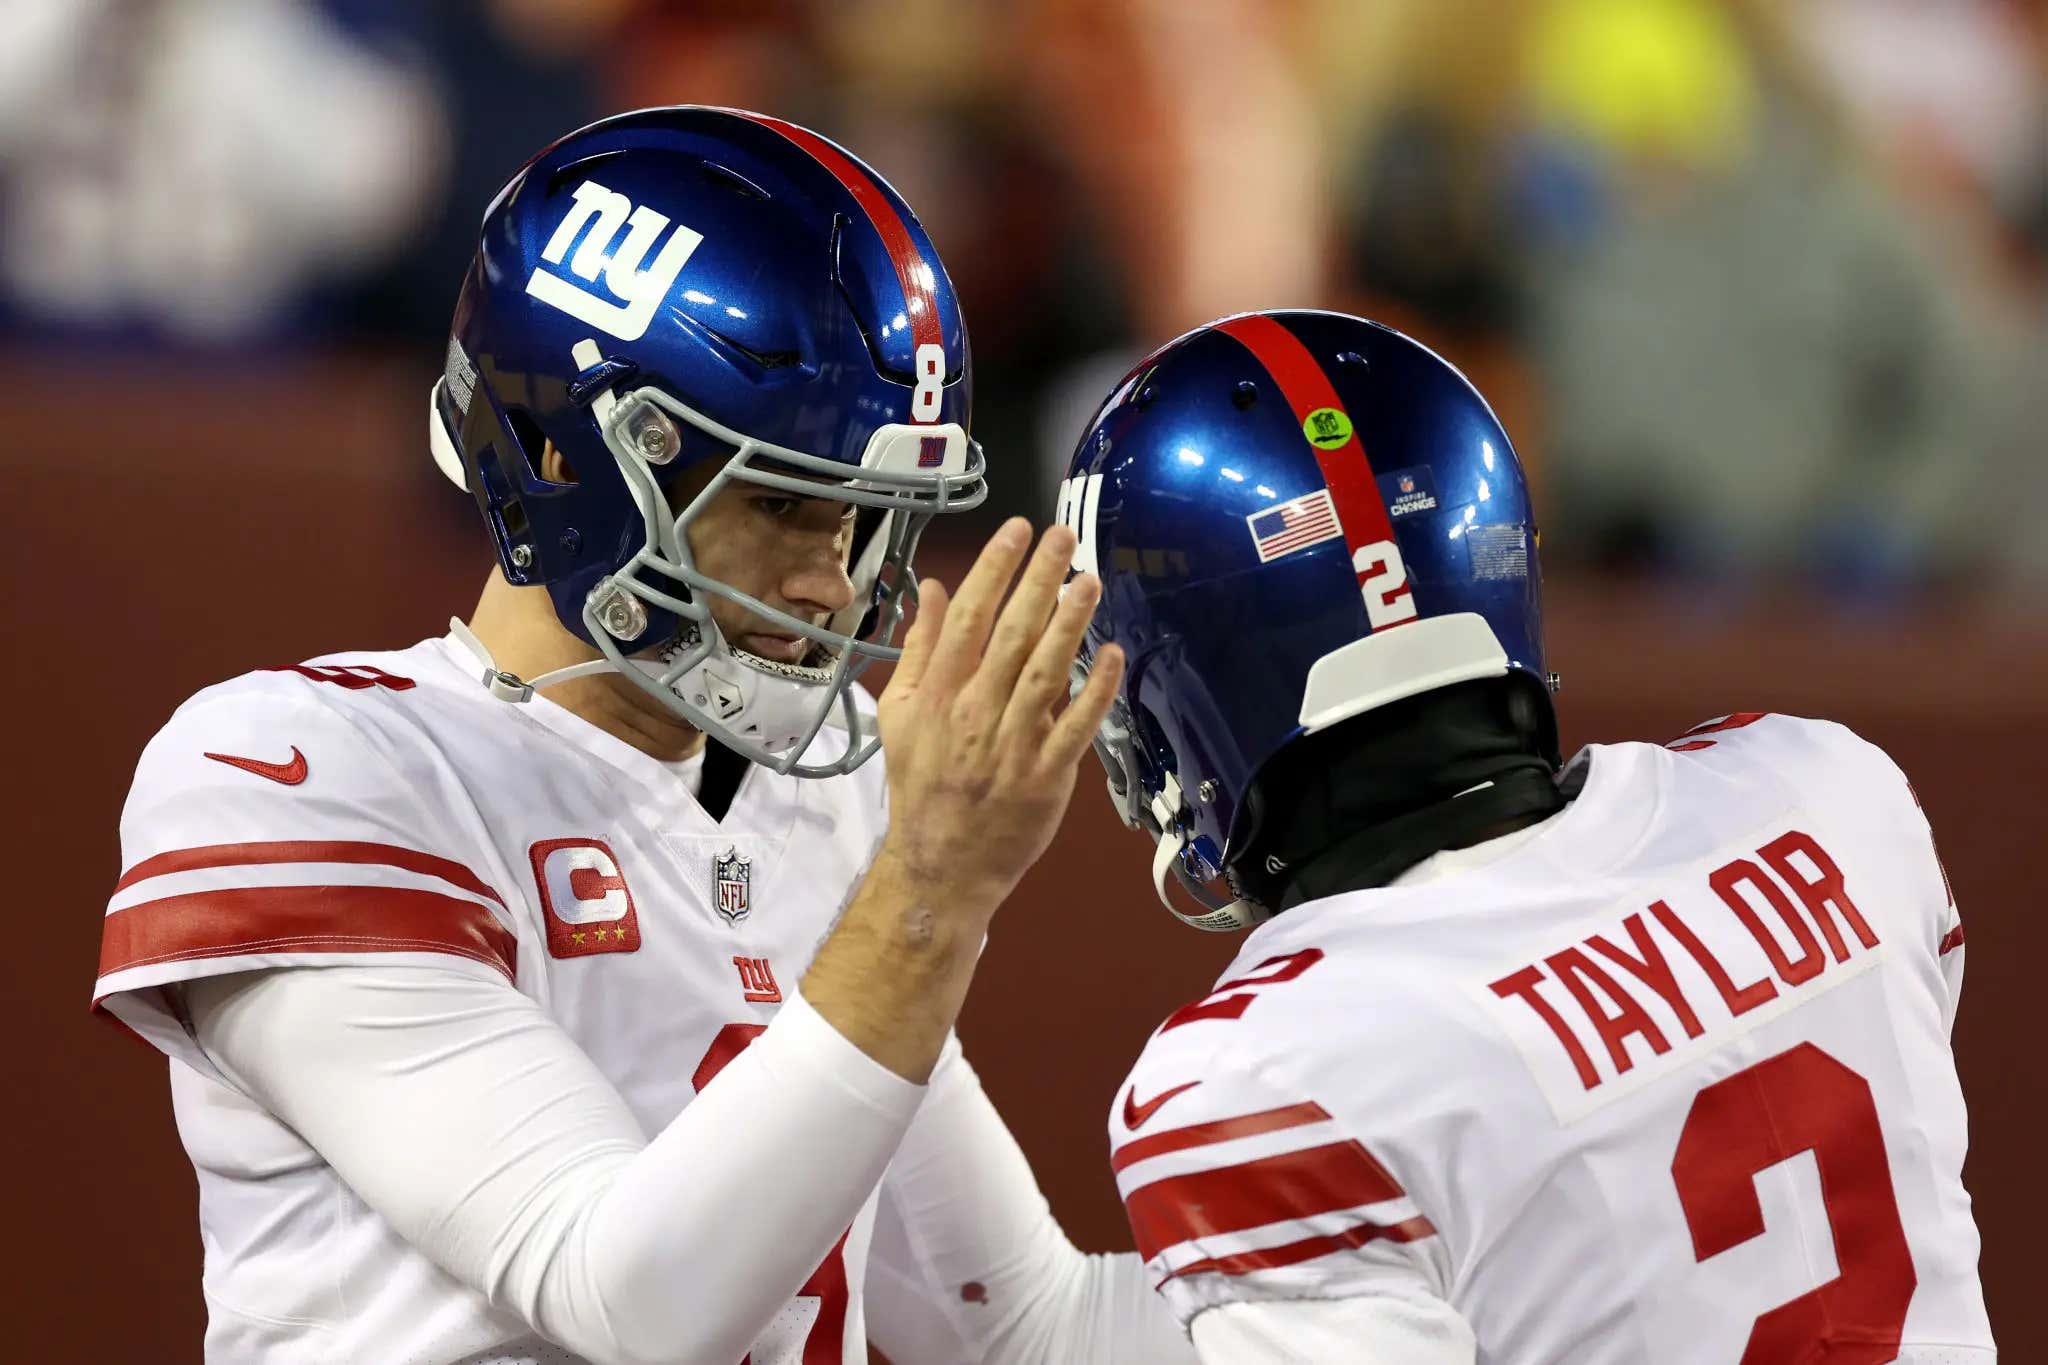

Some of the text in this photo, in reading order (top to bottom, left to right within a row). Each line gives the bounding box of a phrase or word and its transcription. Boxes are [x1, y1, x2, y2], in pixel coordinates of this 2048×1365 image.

[912, 344, 946, 422] 8
[1391, 497, 1437, 516] CHANGE
[1352, 540, 1417, 629] 2
[544, 847, 628, 925] C
[719, 881, 747, 912] NFL
[1489, 830, 1881, 1091] TAYLOR
[1672, 1041, 1918, 1365] 2
